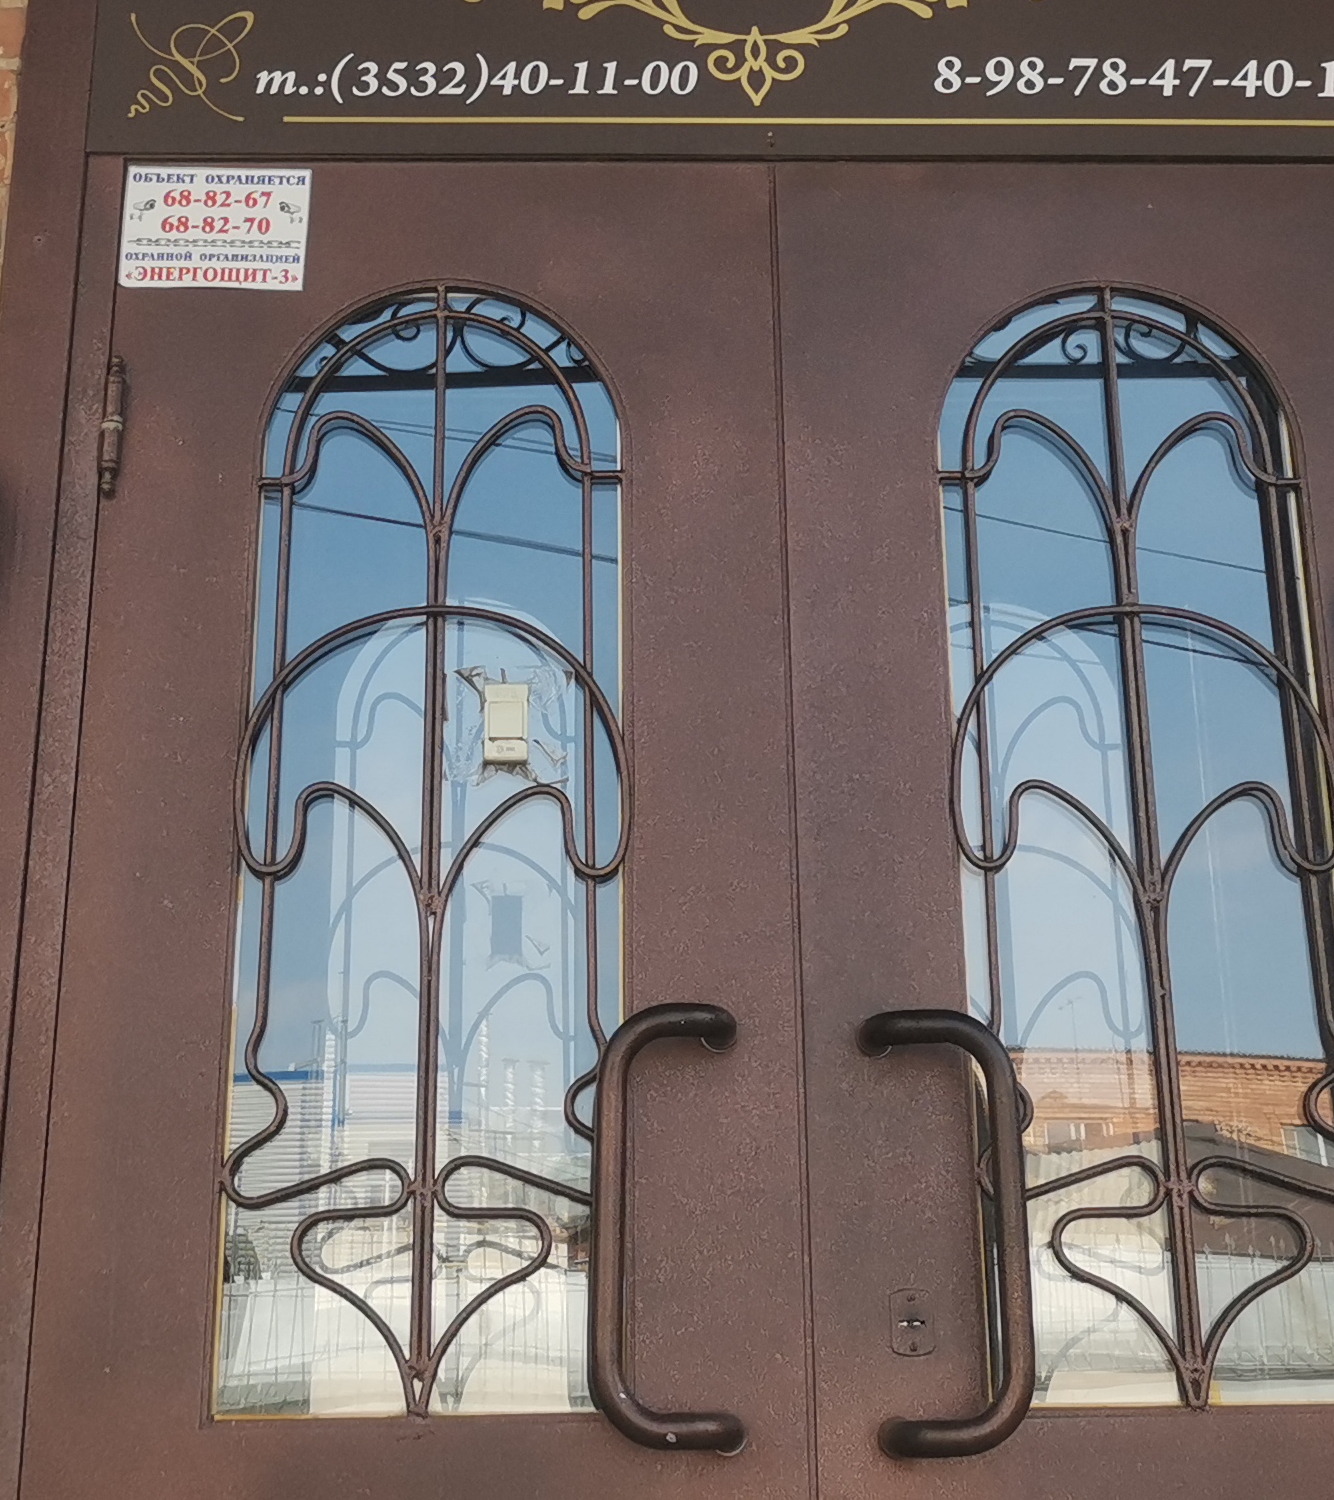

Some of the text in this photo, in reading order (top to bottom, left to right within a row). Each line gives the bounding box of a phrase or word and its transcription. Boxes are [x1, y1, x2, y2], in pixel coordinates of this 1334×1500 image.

[132, 172, 307, 186] ОБЪЕКТ ОХРАНЯЕТСЯ
[163, 188, 274, 209] 68-82-67
[160, 214, 271, 235] 68-82-70
[124, 251, 301, 264] ОХРАННОЙ ОРГАНИЗАЦИЕЙ
[125, 265, 299, 285] «ЭНЕРГОЩИТ-3»
